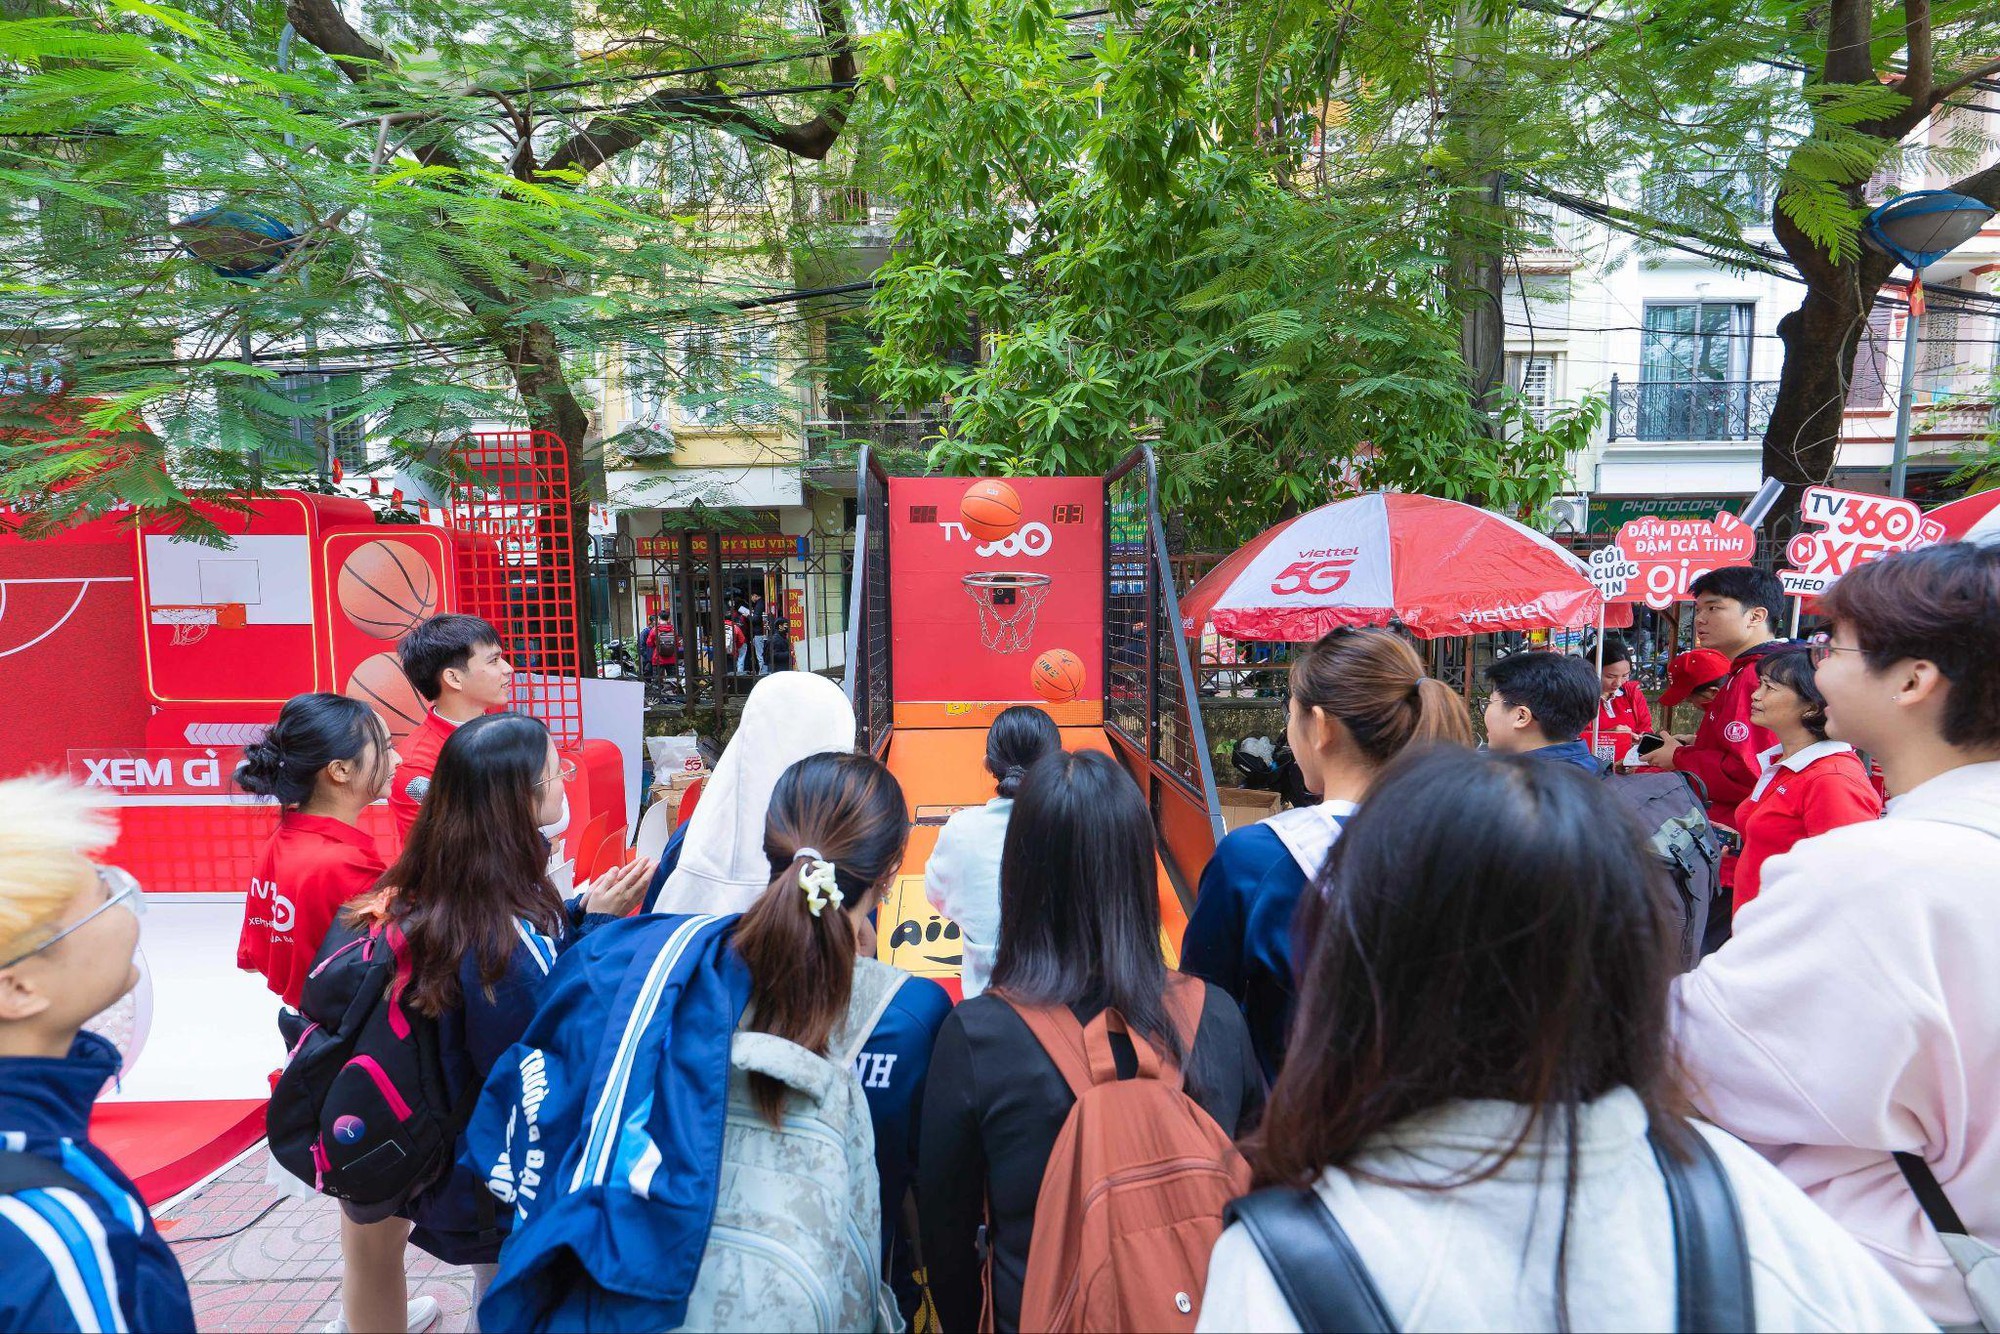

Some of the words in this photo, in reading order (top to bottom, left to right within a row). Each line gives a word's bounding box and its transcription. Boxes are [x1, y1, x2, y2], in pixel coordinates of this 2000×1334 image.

[1620, 501, 1727, 512] PHOTOCOPY
[1811, 493, 1914, 542] TV360
[1670, 523, 1712, 536] DATA
[1299, 546, 1359, 559] viettel
[1635, 536, 1672, 556] ĐẬM
[1704, 533, 1744, 551] TÍNH
[1593, 547, 1621, 564] GÓI
[1270, 559, 1355, 596] 5G
[1593, 562, 1637, 580] CƯỚC
[1784, 577, 1824, 591] THEO
[1459, 601, 1547, 624] viettel
[82, 758, 173, 787] XEM
[183, 748, 220, 787] GÌ
